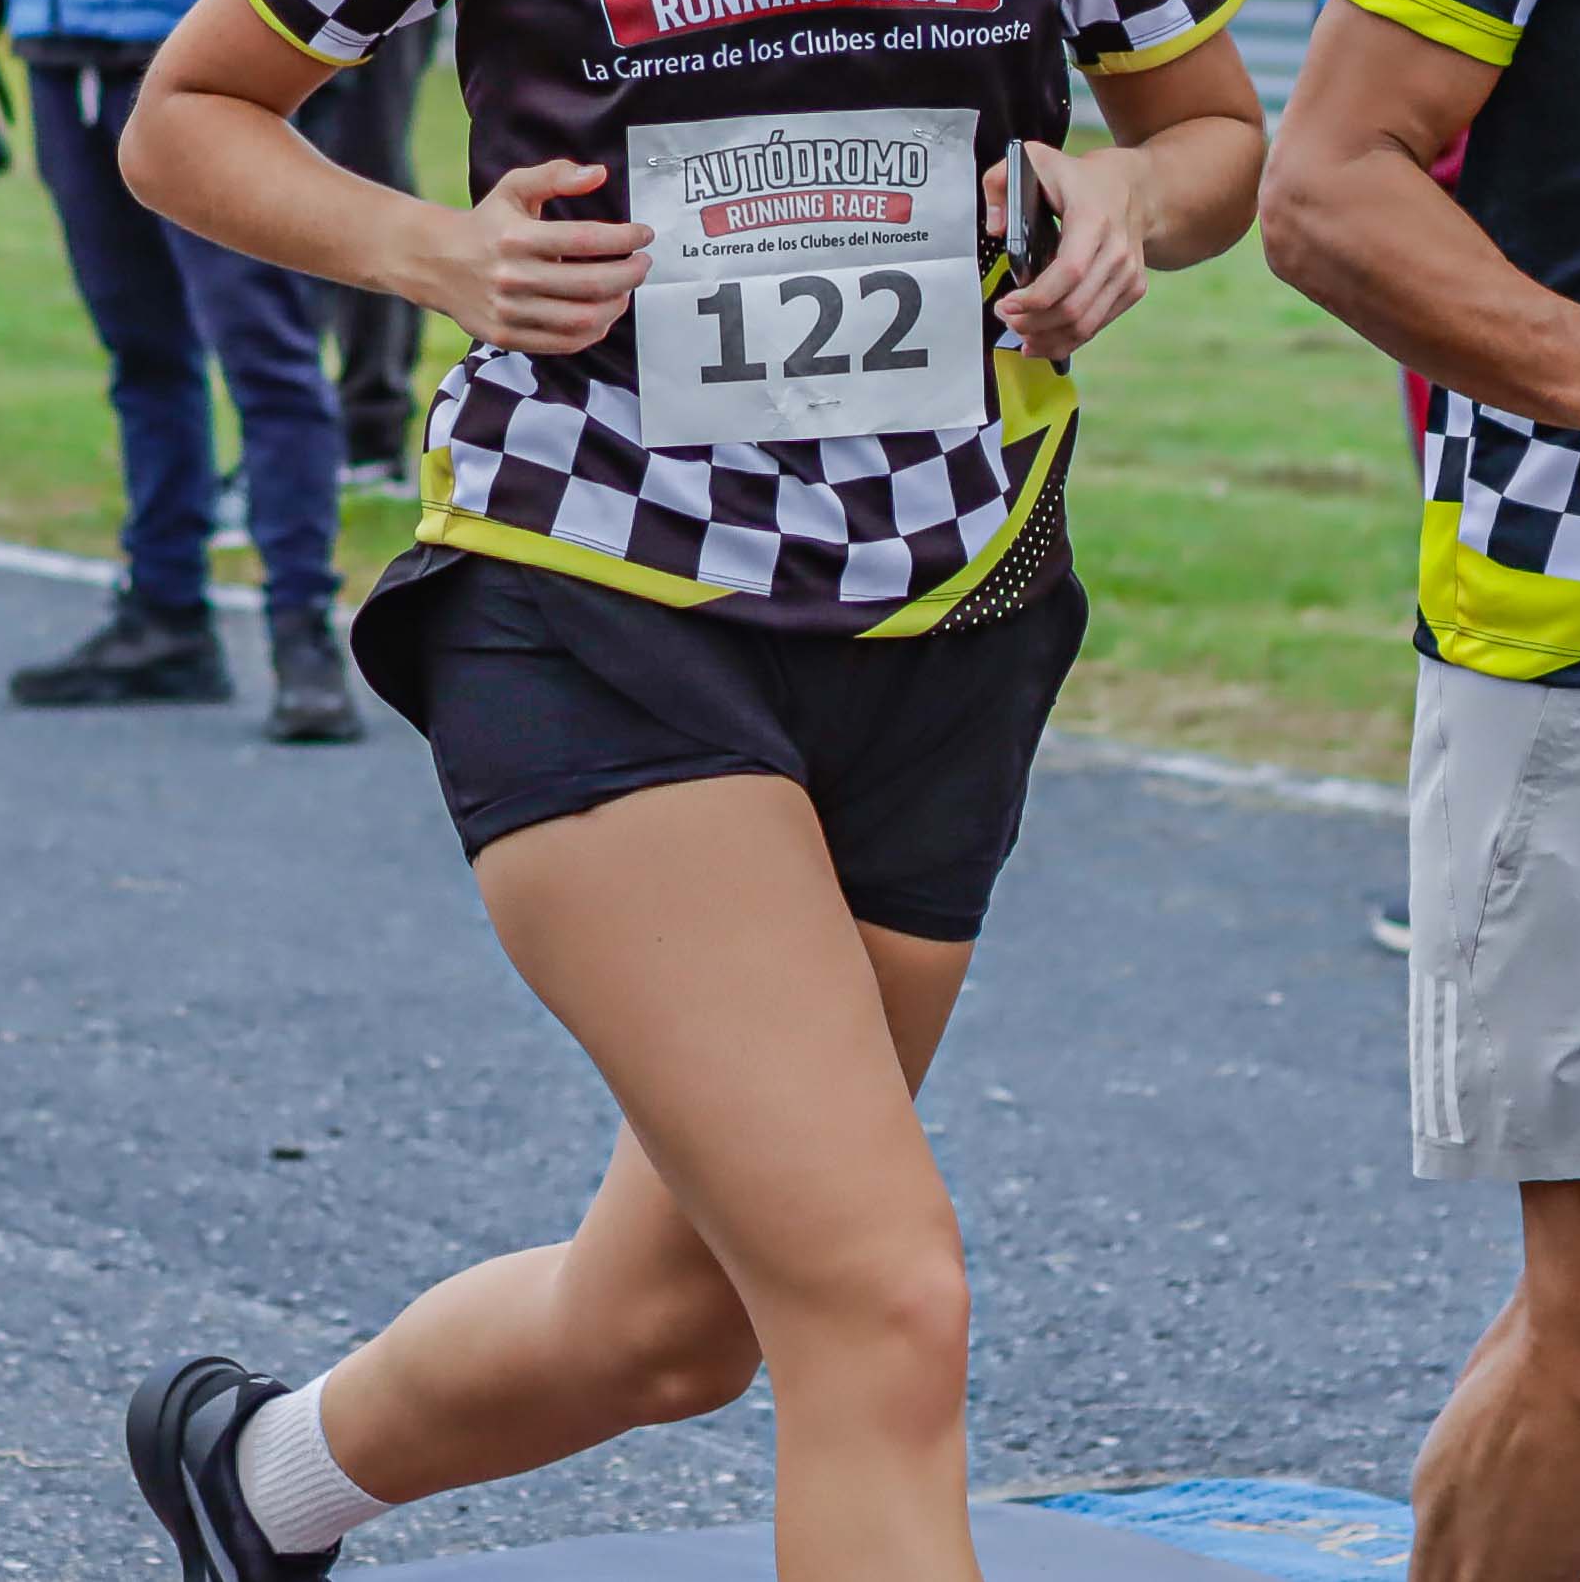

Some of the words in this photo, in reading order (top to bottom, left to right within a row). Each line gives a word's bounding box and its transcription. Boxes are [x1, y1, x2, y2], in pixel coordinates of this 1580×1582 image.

[581, 58, 611, 82] La
[615, 51, 705, 79] Carrera
[712, 40, 744, 68] de
[750, 37, 784, 63] los
[790, 26, 876, 58] Clubes
[883, 24, 923, 51] del
[930, 18, 1032, 50] Noroeste
[683, 129, 929, 205] AUTÓDROMO
[682, 244, 699, 259] La
[702, 241, 754, 257] Carrera
[757, 238, 776, 253] de
[778, 236, 798, 252] los
[800, 233, 846, 251] Clubes
[848, 231, 869, 247] del
[871, 229, 929, 245] Noroeste
[724, 194, 825, 231] RUNNING
[831, 194, 888, 220] RACE
[696, 268, 930, 385] 122
